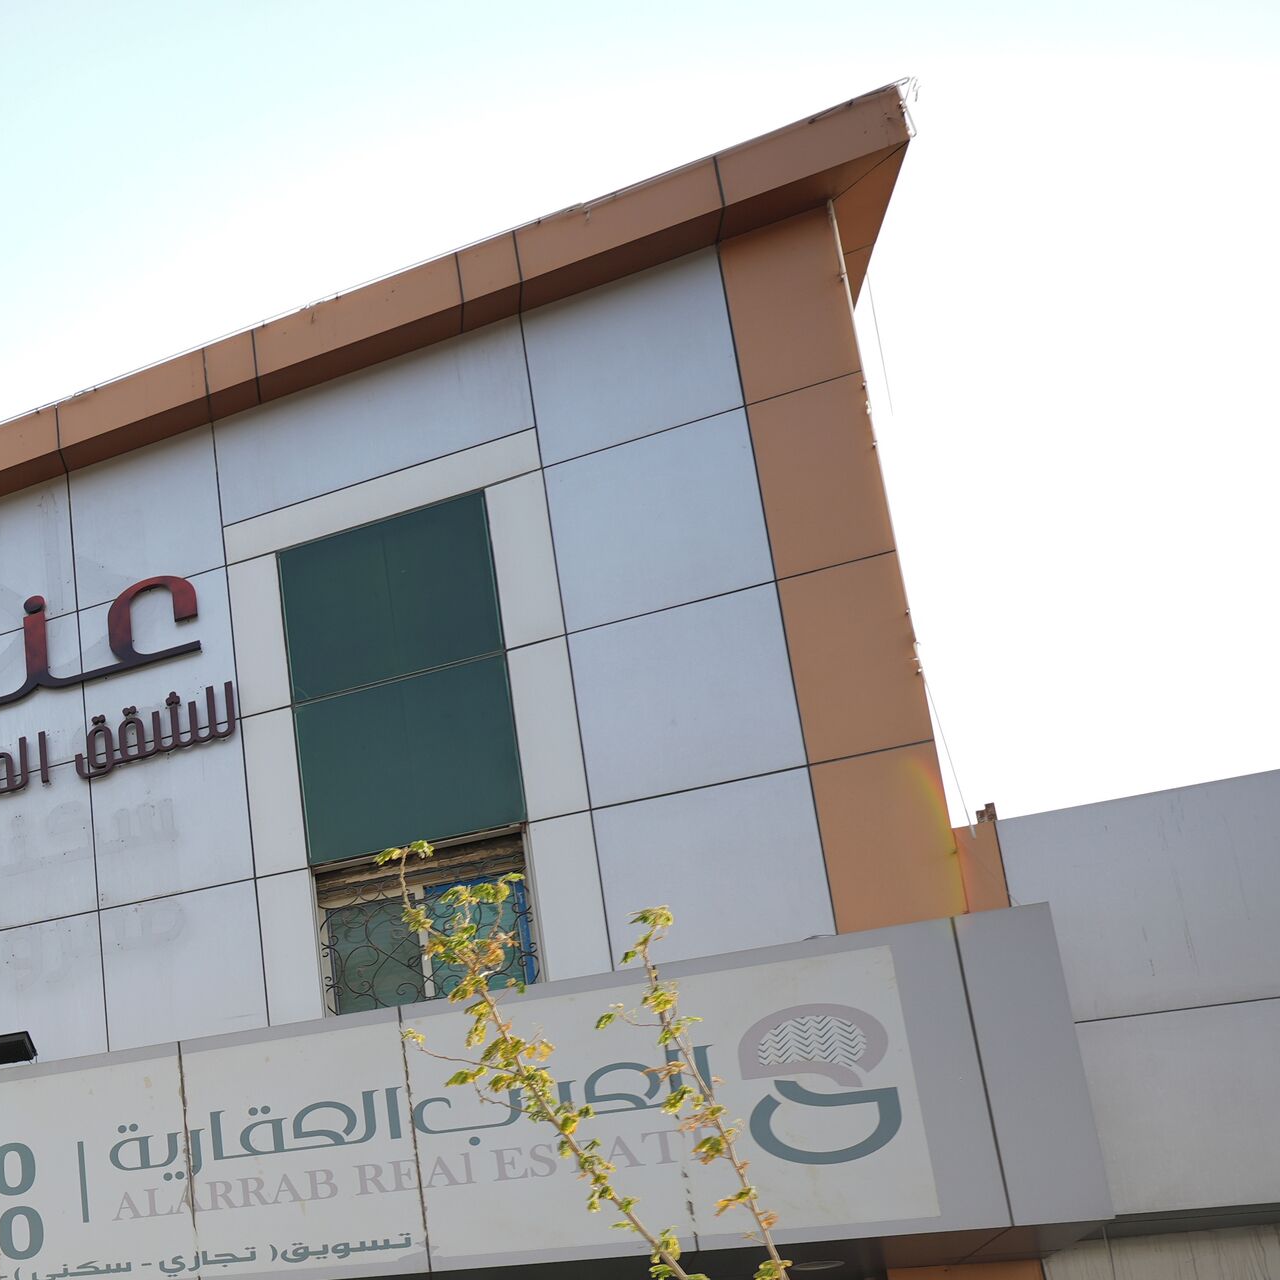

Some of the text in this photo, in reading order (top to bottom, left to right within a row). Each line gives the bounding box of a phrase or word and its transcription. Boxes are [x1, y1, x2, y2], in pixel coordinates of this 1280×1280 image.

[75, 680, 237, 780] للشقق
[109, 1086, 402, 1181] العقارية
[112, 1168, 338, 1221] ALARRAB
[158, 1246, 256, 1277] تجاري
